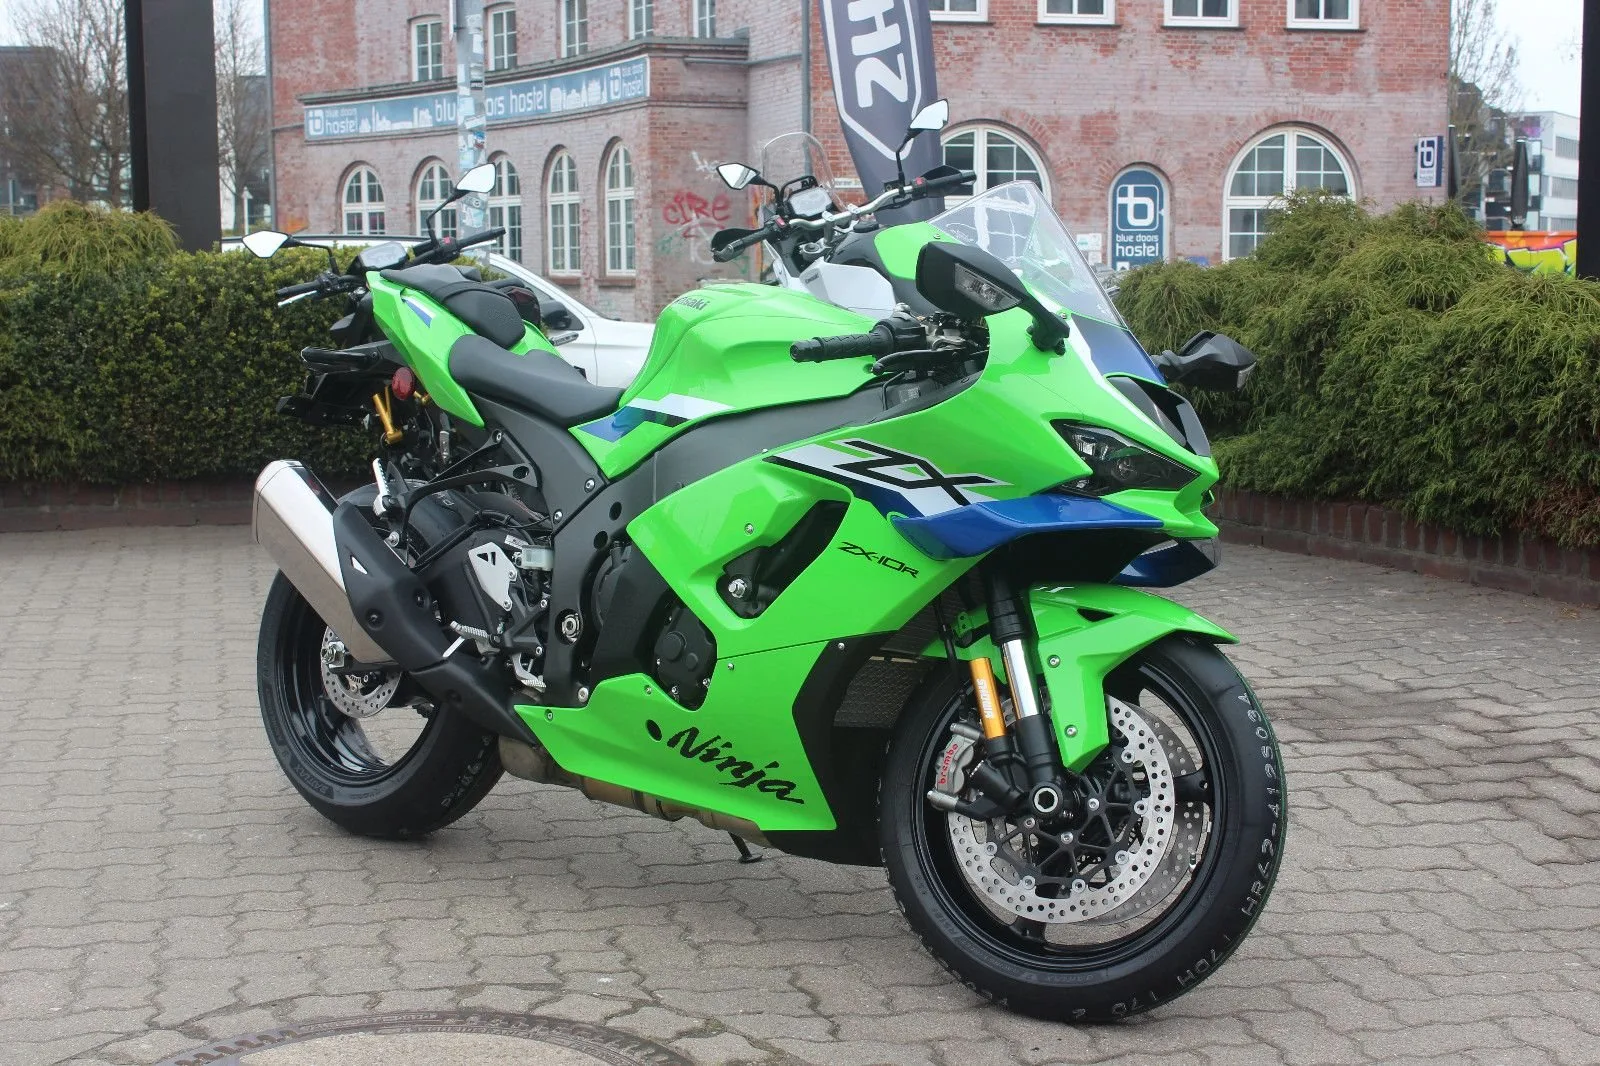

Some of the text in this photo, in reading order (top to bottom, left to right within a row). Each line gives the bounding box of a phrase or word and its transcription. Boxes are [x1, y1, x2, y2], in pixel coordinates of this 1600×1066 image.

[435, 98, 456, 121] blu
[486, 95, 505, 116] ors
[510, 84, 547, 113] hostel
[325, 116, 358, 134] hostel
[1116, 233, 1159, 242] blue doors
[1116, 242, 1159, 257] hostel
[838, 541, 919, 578] ZX-10R
[666, 726, 805, 805] Ninja
[938, 743, 959, 786] brembo
